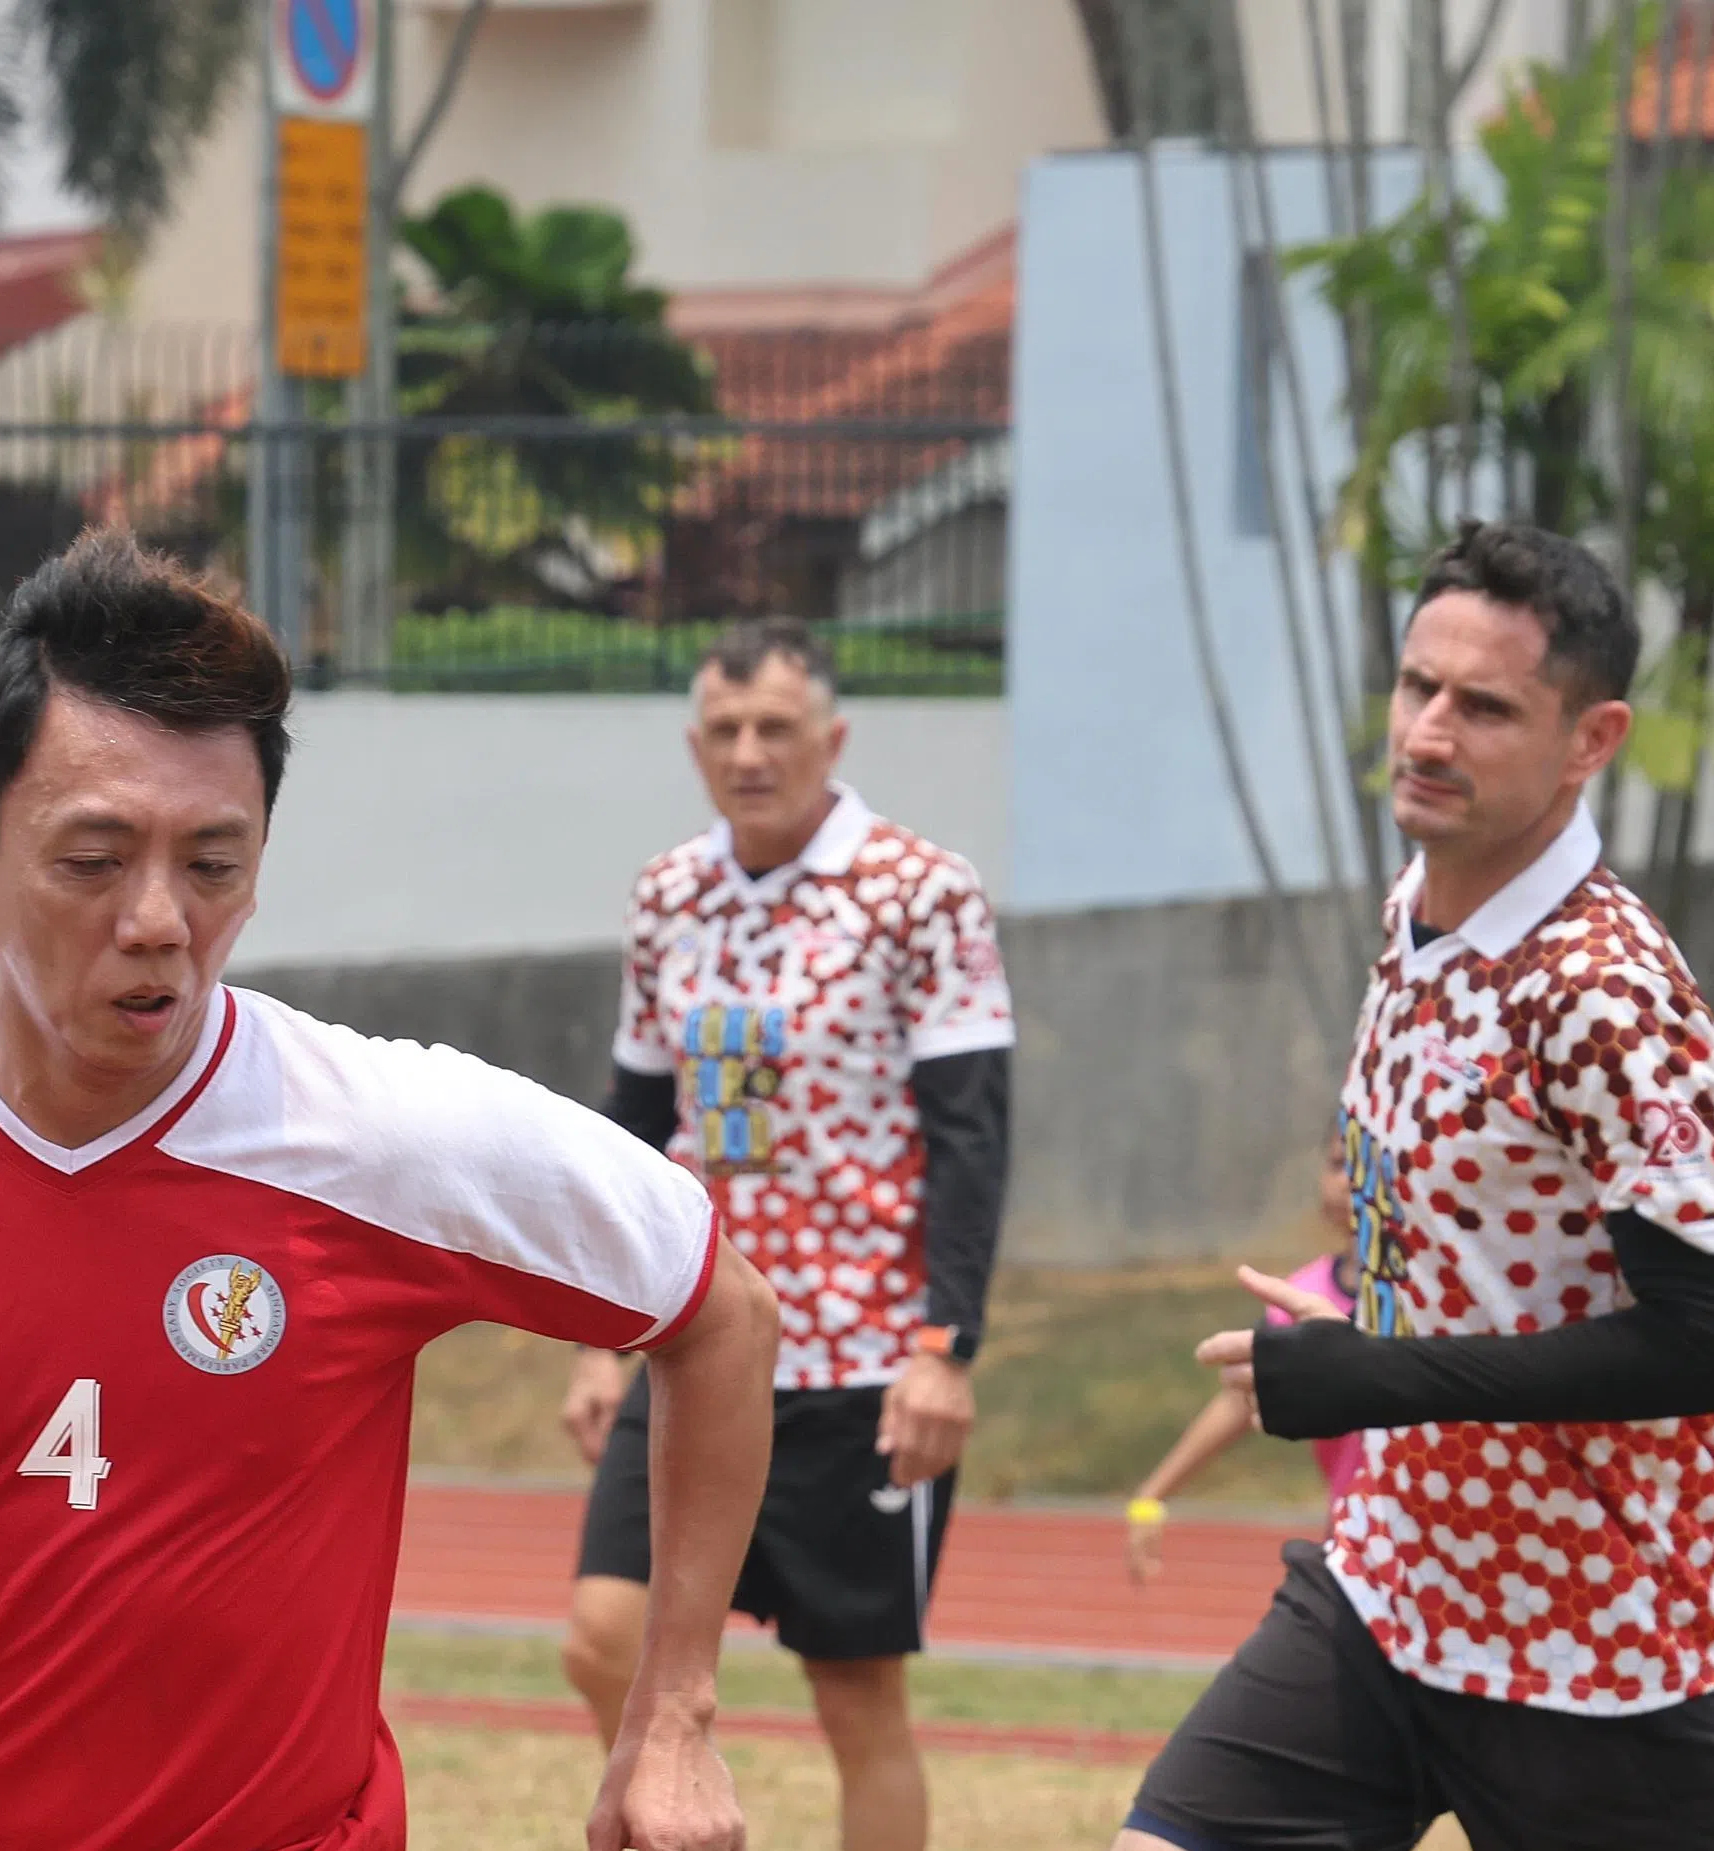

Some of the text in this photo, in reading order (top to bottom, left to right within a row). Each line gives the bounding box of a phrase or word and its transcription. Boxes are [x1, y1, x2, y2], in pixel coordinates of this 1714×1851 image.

[166, 1257, 283, 1371] SINGAPORE PARLIAMENTARY SOCIETY
[16, 1378, 112, 1510] 4
